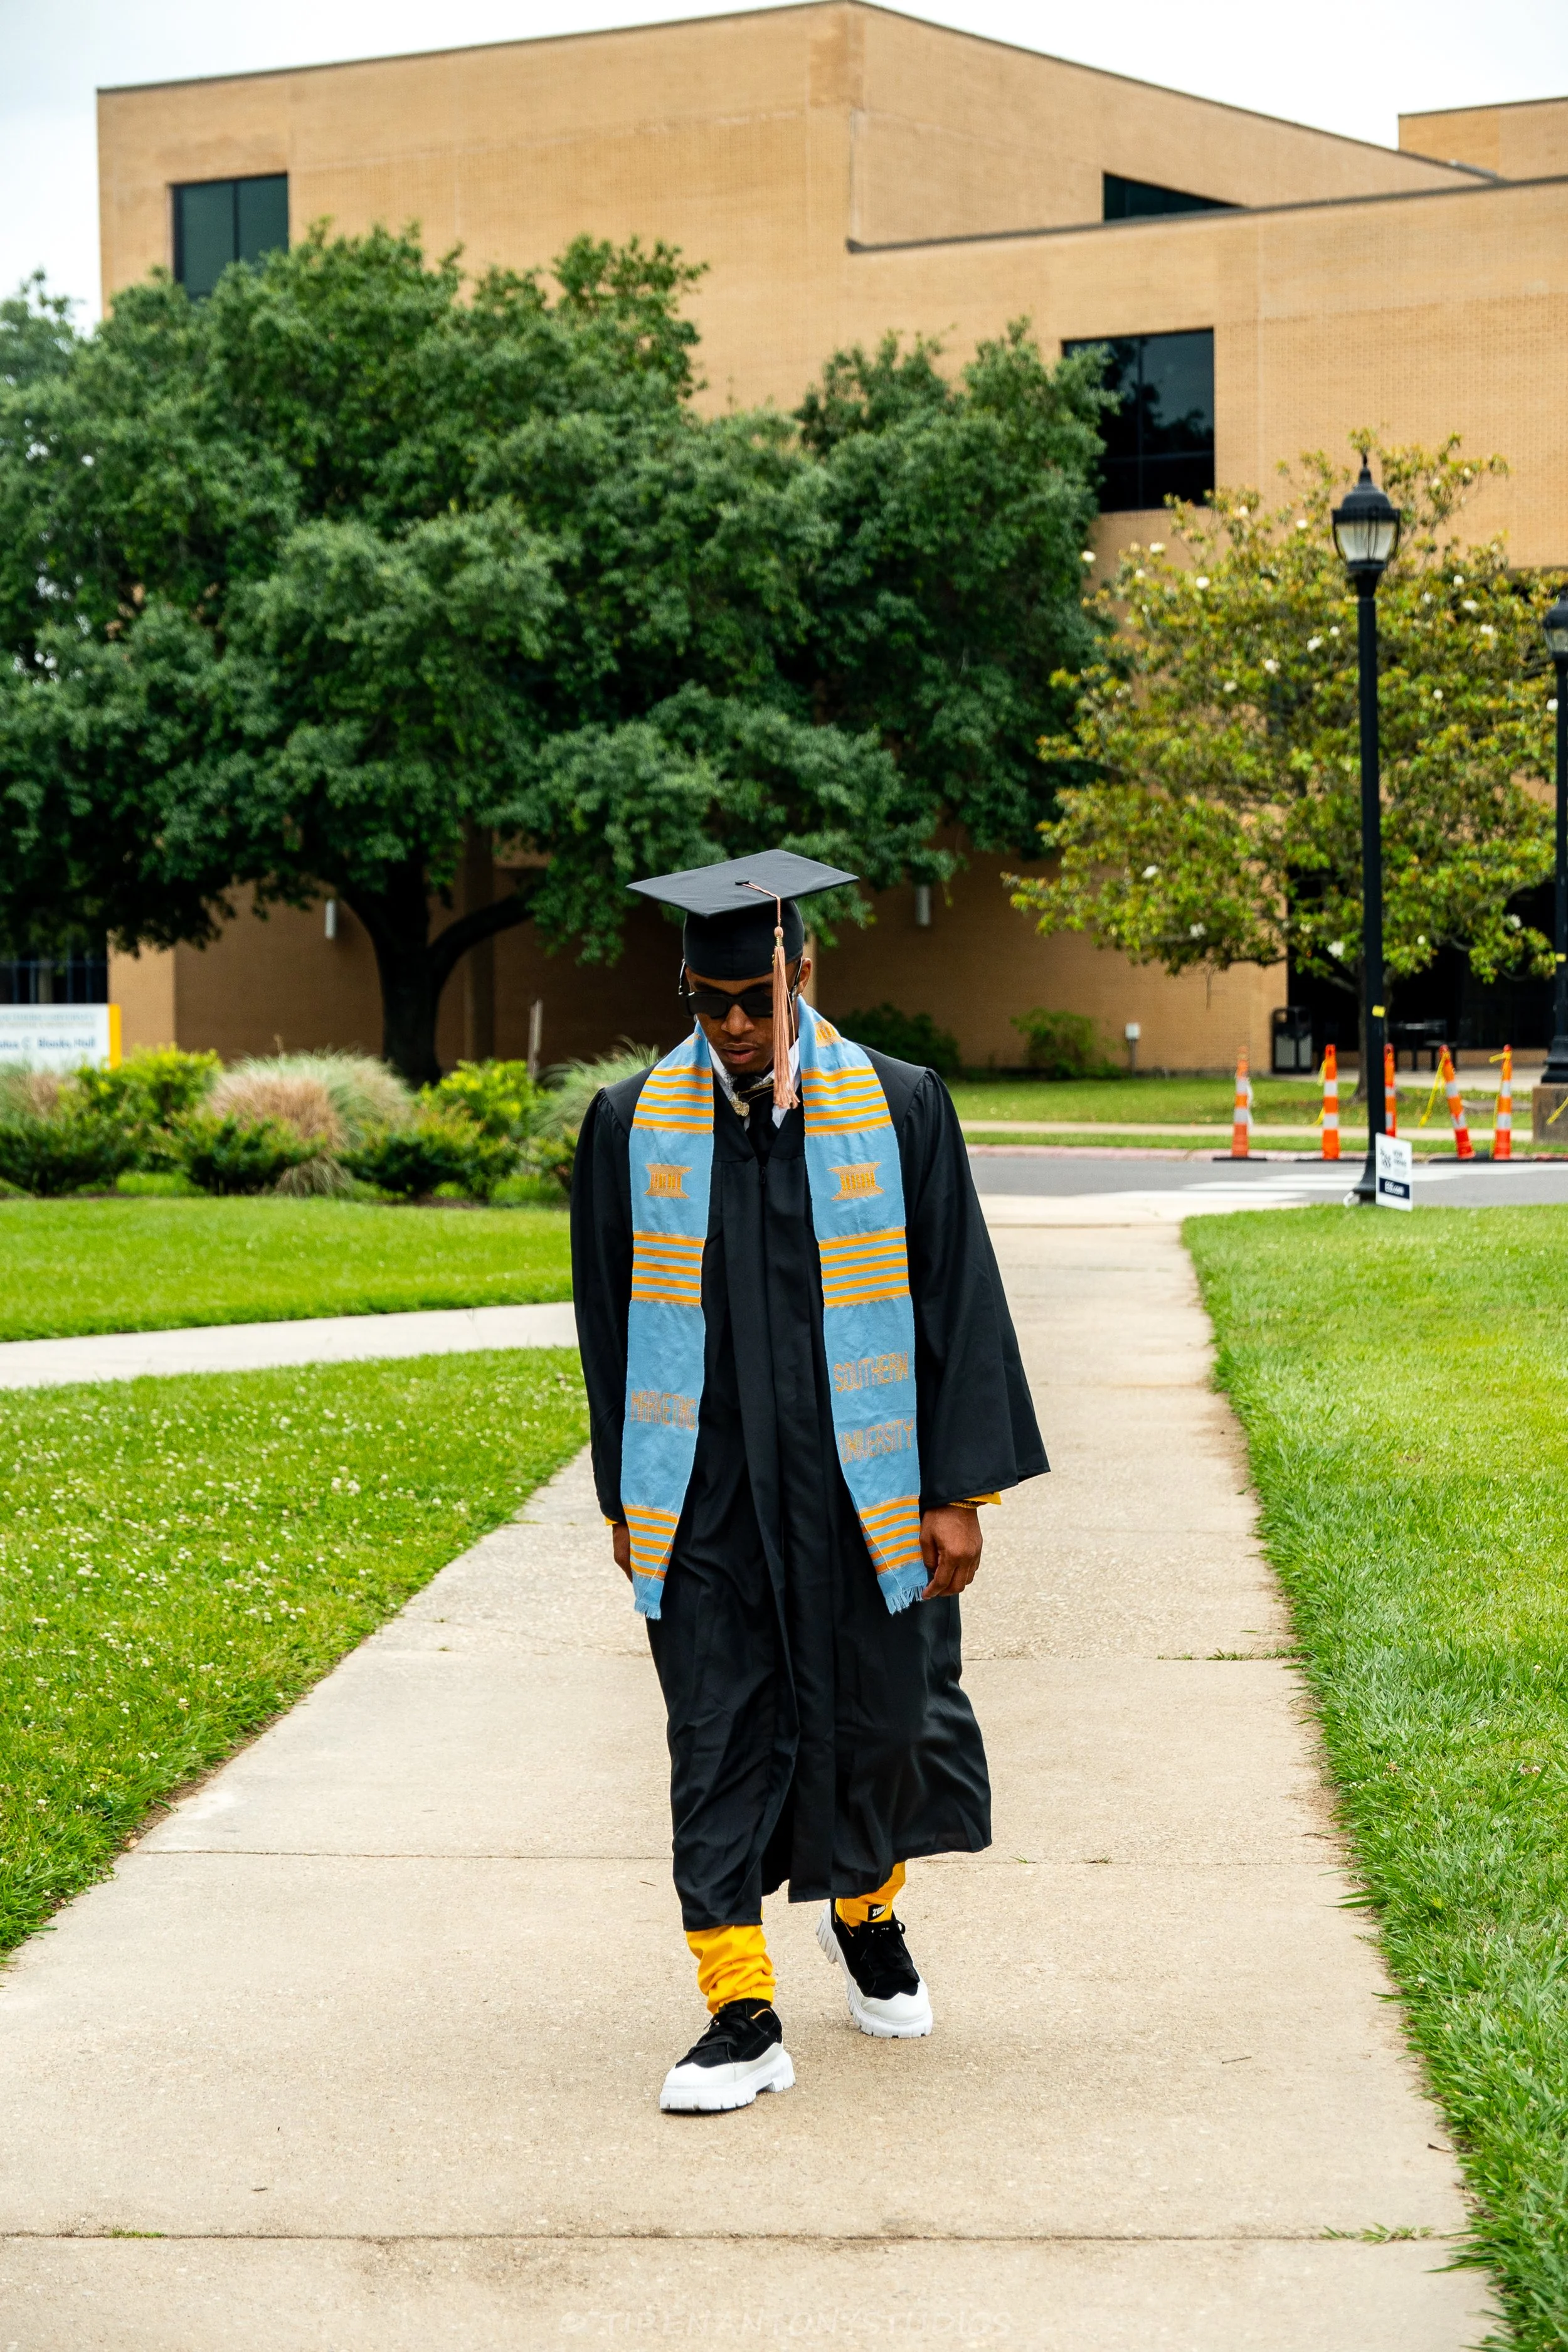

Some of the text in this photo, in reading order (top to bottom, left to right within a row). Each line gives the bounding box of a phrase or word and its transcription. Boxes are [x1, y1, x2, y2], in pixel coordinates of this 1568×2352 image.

[834, 1351, 909, 1392] SOUTHERN
[630, 1390, 697, 1431] MARKETING
[838, 1417, 914, 1465] UNIVERSITY
